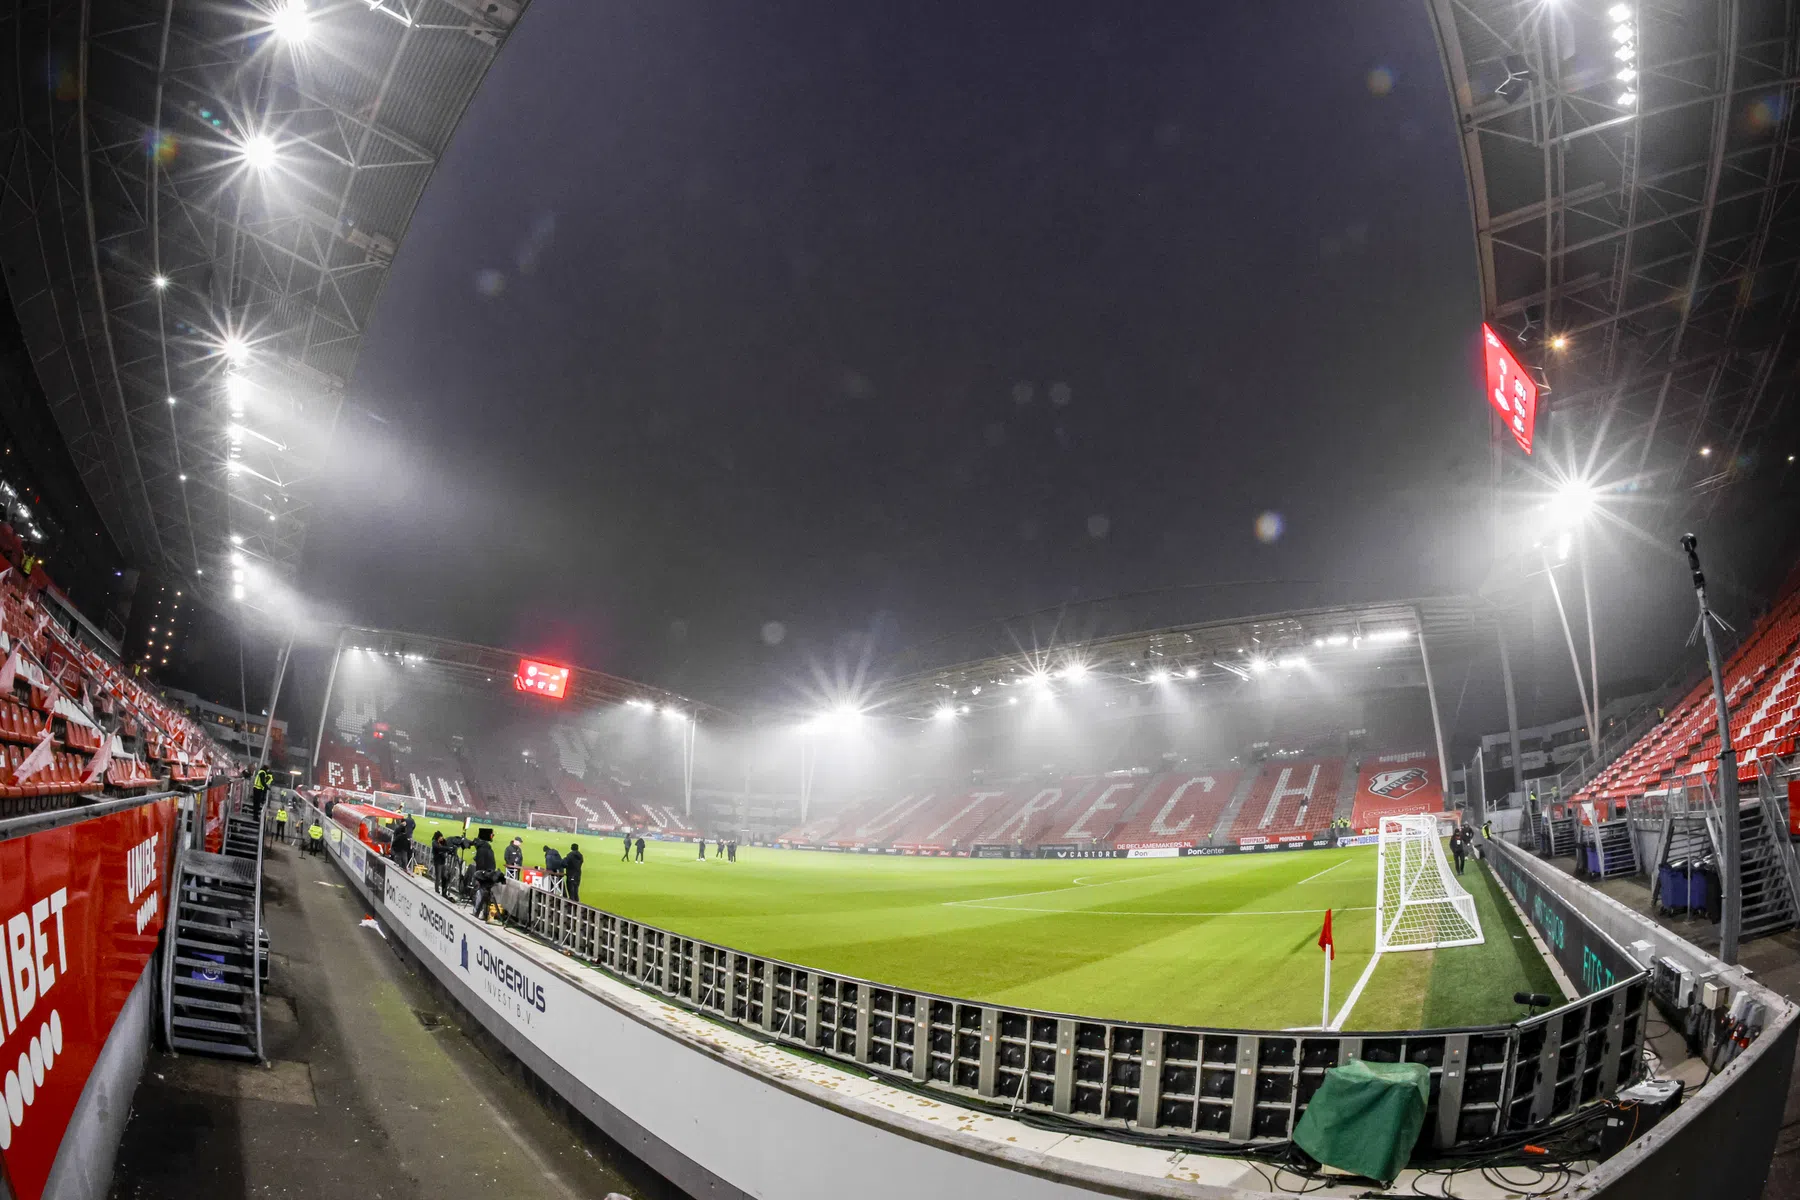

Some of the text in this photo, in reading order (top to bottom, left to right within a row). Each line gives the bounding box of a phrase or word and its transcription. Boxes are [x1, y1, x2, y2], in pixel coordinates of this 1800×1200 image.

[1378, 770, 1421, 795] UTRECHT
[1367, 804, 1426, 817] CONCLUSION
[127, 831, 159, 904] UNIBE
[1187, 847, 1225, 856] PonCenter
[419, 902, 455, 944] JONGERIUS
[476, 945, 546, 1013] JONGERIUS
[484, 978, 535, 1030] INVEST B.V.
